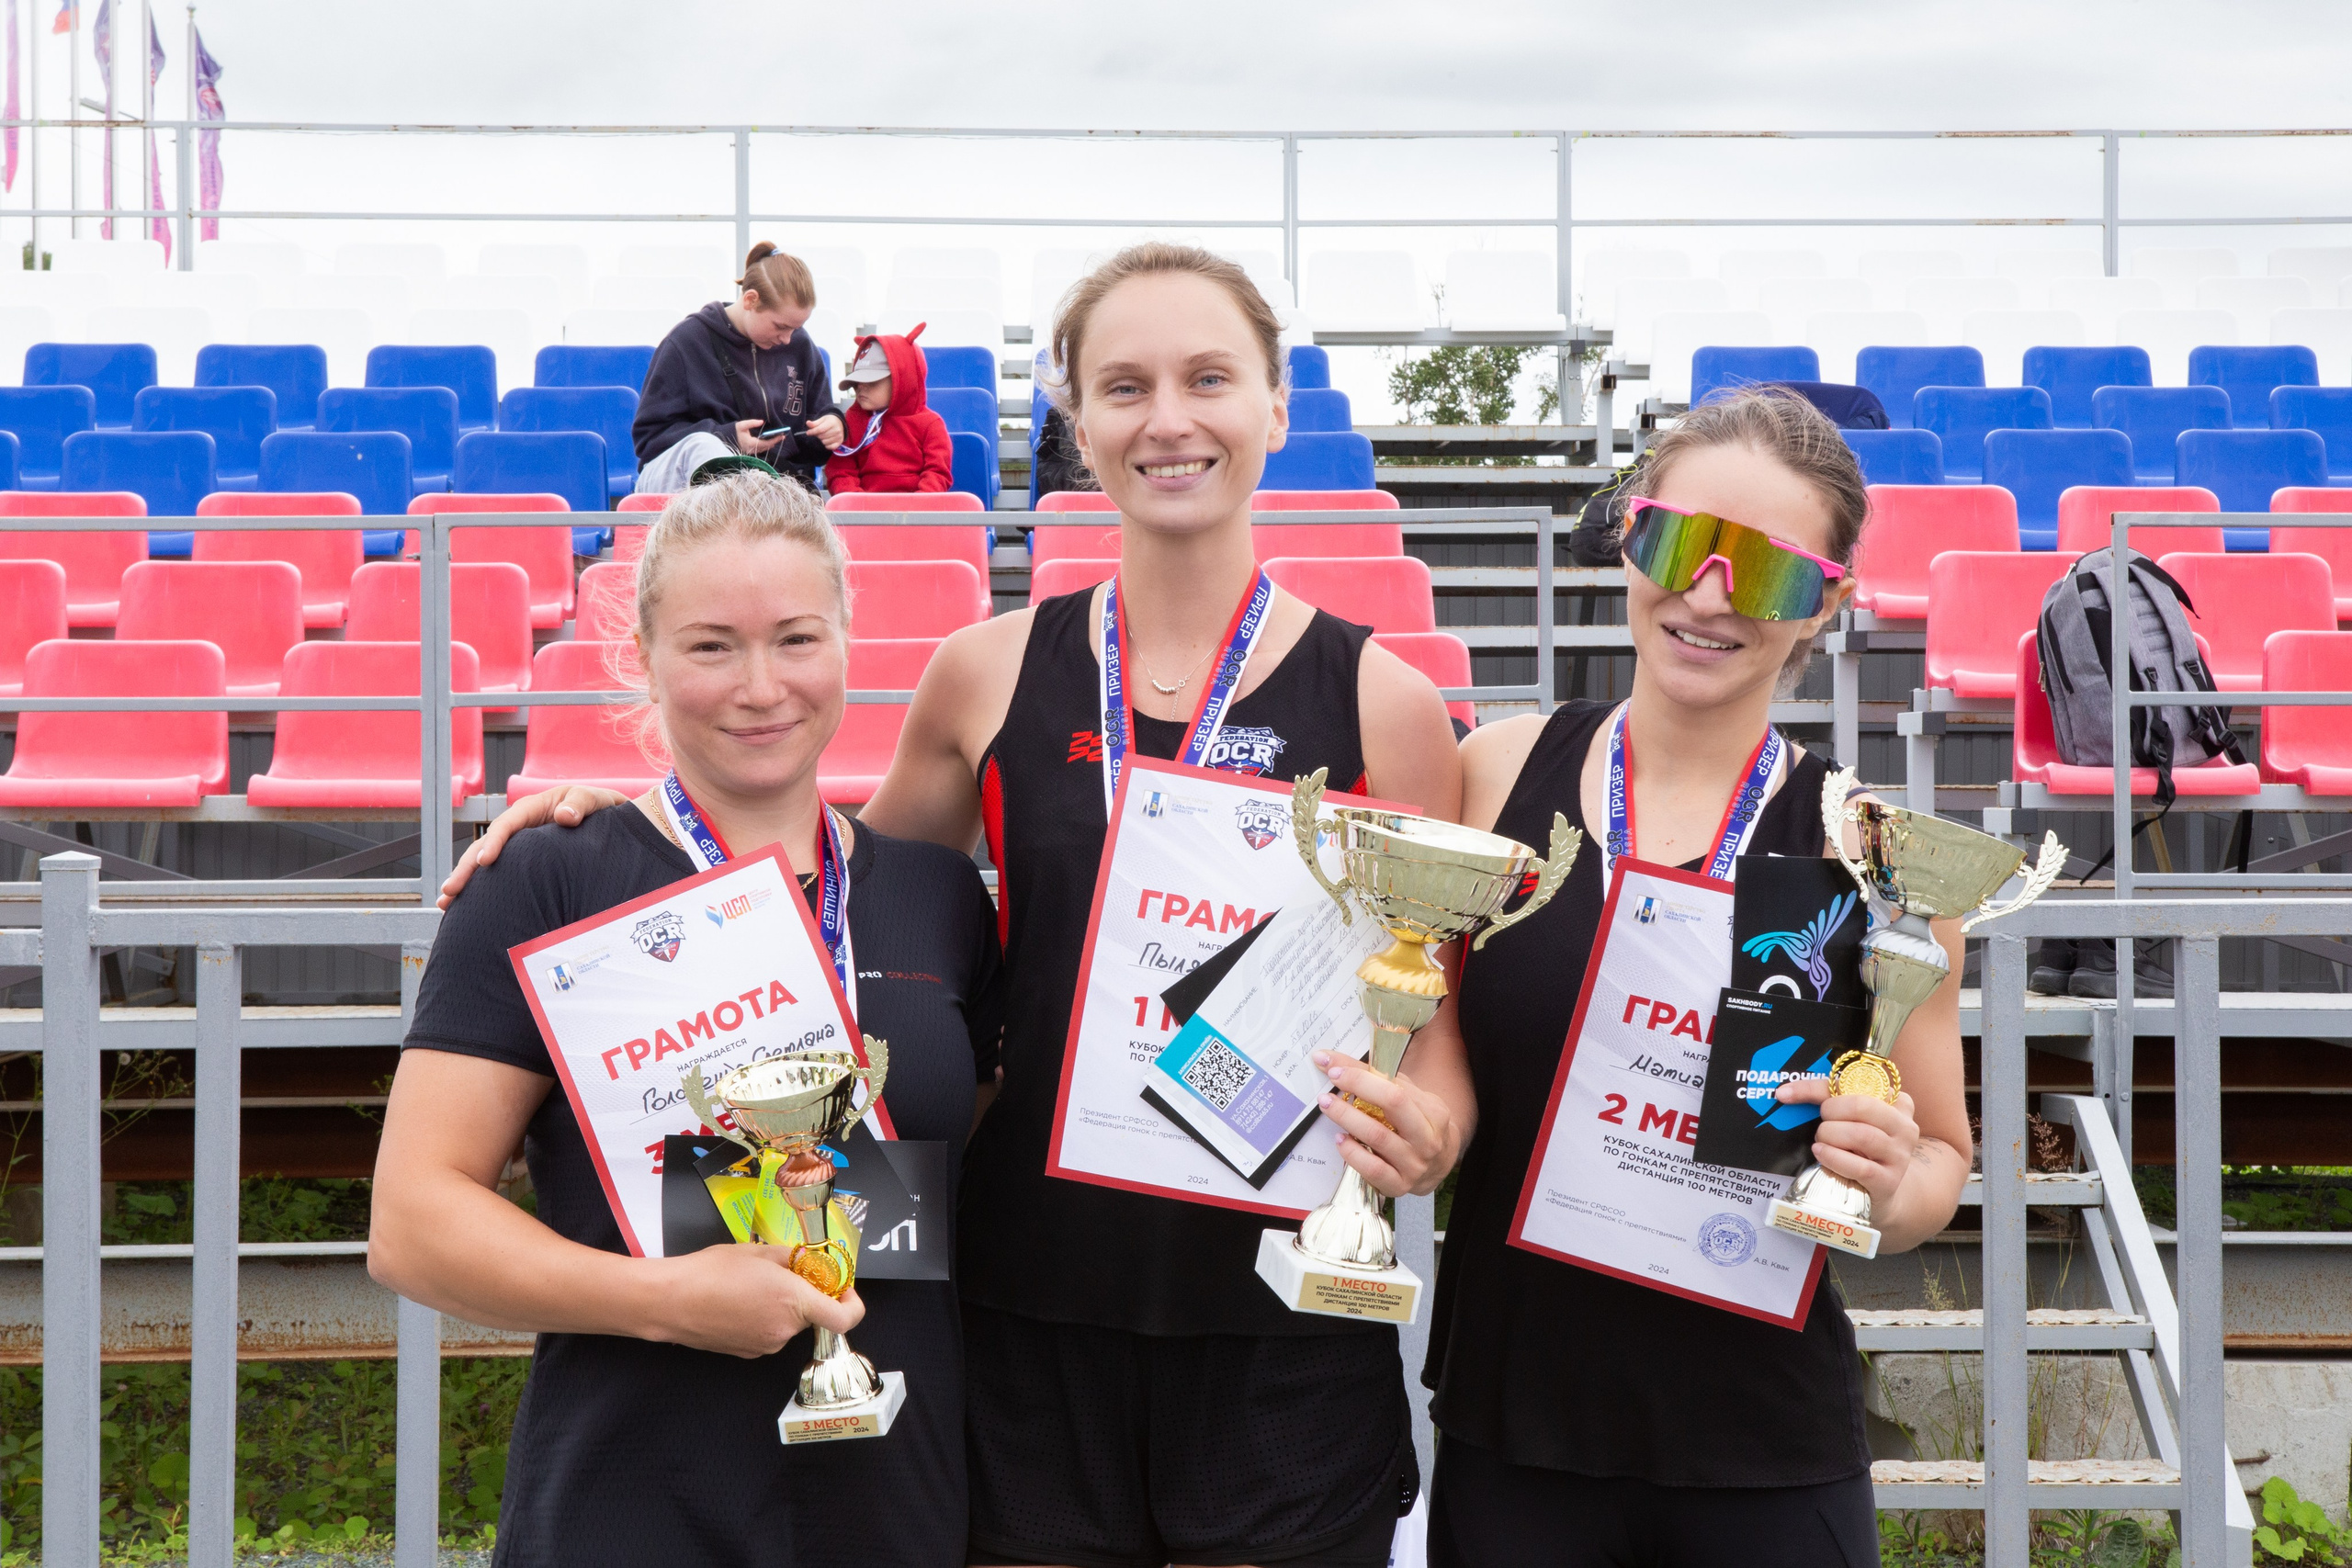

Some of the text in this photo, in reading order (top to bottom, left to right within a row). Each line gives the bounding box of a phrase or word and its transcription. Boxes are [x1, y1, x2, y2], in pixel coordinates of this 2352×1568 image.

[1239, 586, 1268, 639] ПРИЗЁР
[1105, 644, 1121, 696] ПРИЗЁР
[1192, 697, 1223, 752] ПРИЗЁР
[1219, 735, 1270, 743] FEDERATION
[1210, 742, 1273, 767] OCR
[1756, 728, 1780, 776] ПРИЗЁР
[1610, 764, 1625, 818] ПРИЗЁР
[1246, 807, 1282, 817] FEDERATION
[1238, 812, 1284, 839] OCR
[1710, 831, 1740, 880] ПРИЗЁ
[823, 860, 838, 930] ФИНИШЕР
[639, 918, 673, 935] FEDERATION
[639, 923, 685, 953] OCR
[858, 971, 882, 979] PRO
[1340, 994, 1354, 1010] СРОК
[1727, 997, 1772, 1009] SAKHBODY.RU
[601, 979, 798, 1081] ГРАМОТА
[676, 1037, 748, 1073] НАГРАЖДАЕТСЯ
[1130, 1052, 1146, 1062] ПО
[1080, 1107, 1159, 1128] Президент СРФСОО
[1597, 1093, 1628, 1125] 2
[1079, 1116, 1126, 1131] «Федерация
[1127, 1125, 1150, 1135] гонок
[1307, 1156, 1327, 1166] Квак
[1603, 1134, 1781, 1190] КУБОК САХАЛИНСКОЙ ОБЛАСТИ
[1603, 1145, 1774, 1199] ПО ГОНКАМ С ПРЕПЯТСТВИЯМИ
[1187, 1175, 1209, 1185] 2024
[1617, 1161, 1753, 1205] ДИСТАНЦИЯ 100 МЕТРОВ
[1547, 1188, 1626, 1217] Президент СРФСОО
[1545, 1197, 1593, 1215] «Федерация
[1594, 1212, 1617, 1224] гонок
[1624, 1220, 1687, 1243] препятствиями»
[1794, 1211, 1854, 1237] 2 МЕСТО
[1842, 1237, 1860, 1247] 2024
[1647, 1263, 1670, 1275] 2024
[1753, 1257, 1791, 1271] А.В. Квак
[1333, 1277, 1387, 1293] 1 МЕСТО
[1335, 1287, 1376, 1297] САХАЛИНСКОЙ
[1376, 1292, 1402, 1301] ОБЛАСТИ
[1323, 1298, 1357, 1307] ДИСТАНЦИЯ
[1353, 1296, 1400, 1306] ПРЕПЯТСТВИЯМИ
[803, 1416, 859, 1430] 3 МЕСТО
